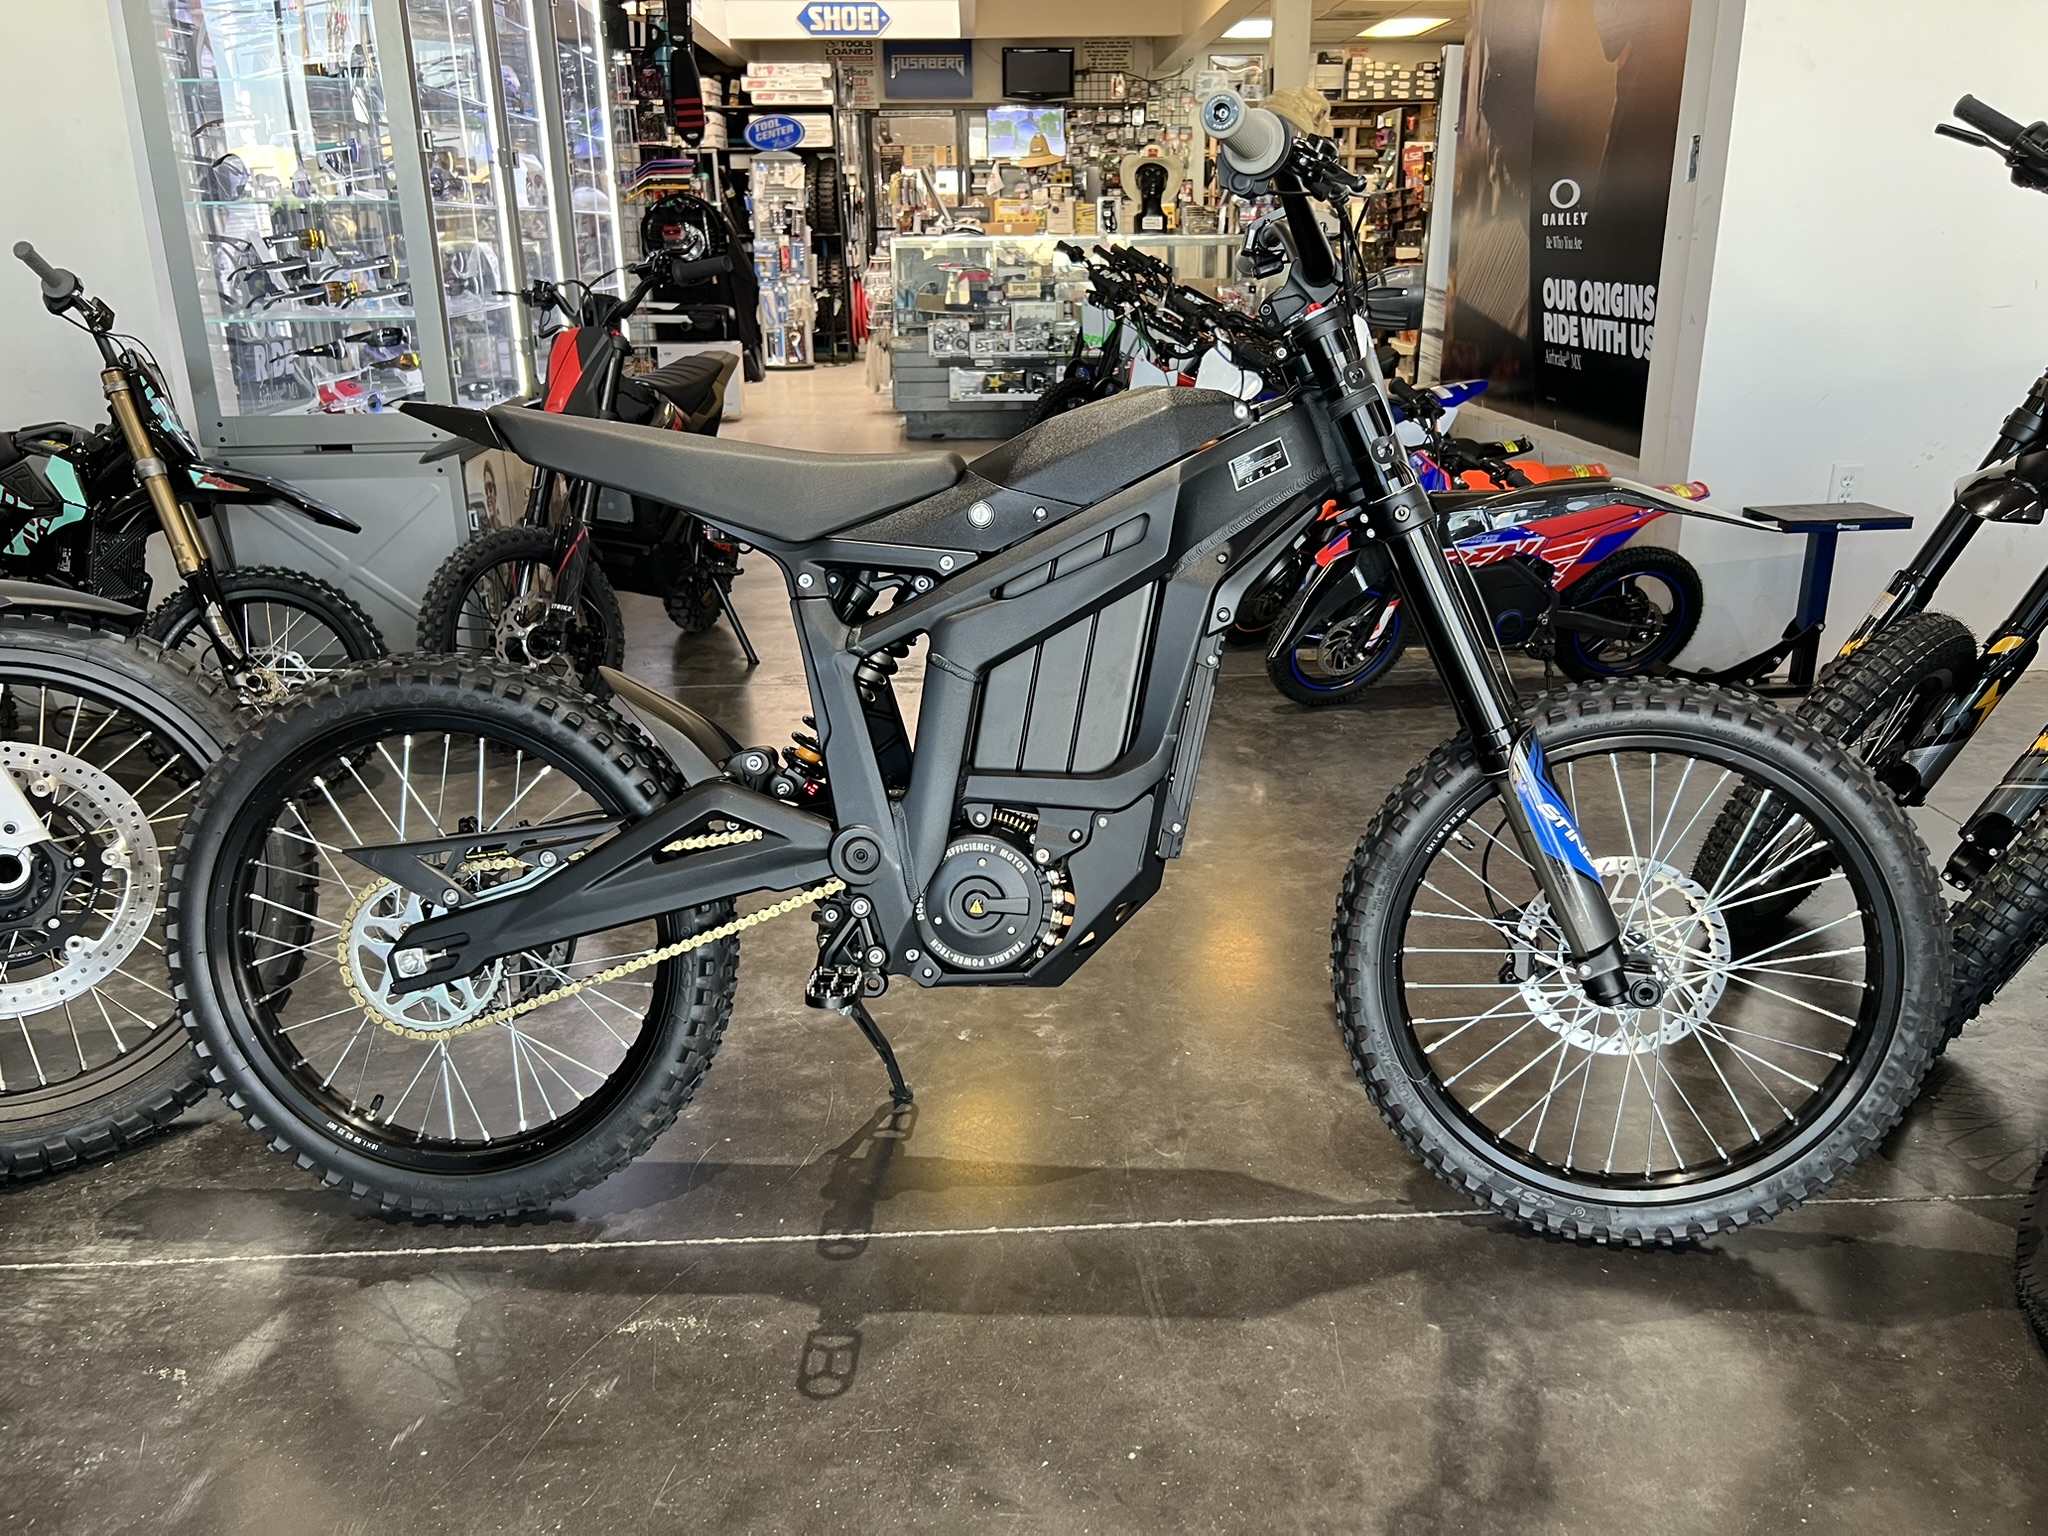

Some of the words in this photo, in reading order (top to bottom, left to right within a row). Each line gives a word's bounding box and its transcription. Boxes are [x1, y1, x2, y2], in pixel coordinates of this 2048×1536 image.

[807, 6, 880, 31] SHOEI
[825, 48, 873, 56] LOANED
[890, 54, 966, 78] HUSABERG
[753, 119, 782, 133] TOOL
[755, 124, 795, 143] CENTER
[1542, 211, 1588, 226] OAKLEY
[1553, 235, 1564, 249] Who
[1564, 236, 1574, 249] You
[1574, 237, 1583, 250] Are
[1543, 277, 1578, 312] OUR
[1580, 280, 1656, 322] ORIGINS
[1543, 311, 1579, 347] RIDE
[1581, 317, 1626, 355] WITH
[1630, 324, 1655, 362] US
[999, 848, 1029, 874] MOTOR
[988, 940, 1026, 966] TALARIA
[1503, 1185, 1556, 1208] CST
